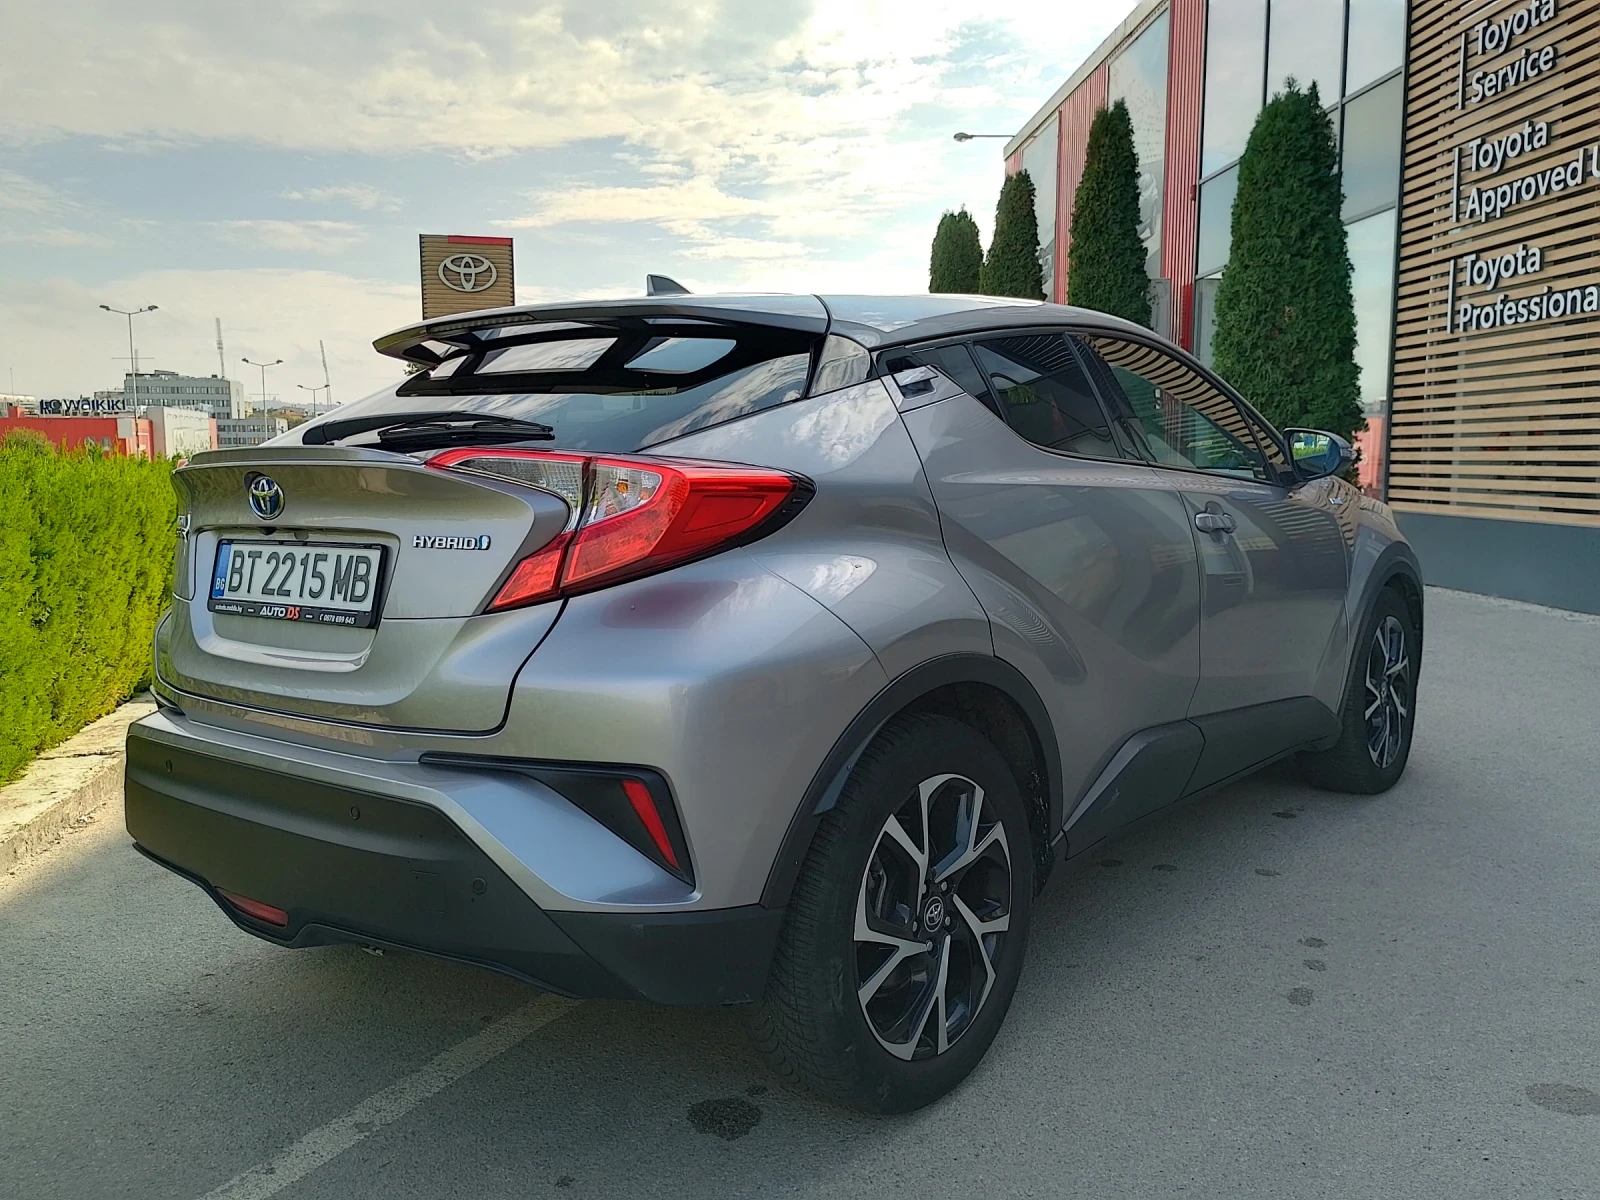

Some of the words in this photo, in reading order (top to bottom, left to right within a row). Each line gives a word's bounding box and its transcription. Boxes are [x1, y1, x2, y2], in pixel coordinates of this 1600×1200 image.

[1474, 0, 1556, 55] Toyota
[1471, 46, 1555, 104] Service
[1469, 120, 1548, 173] Toyota
[1465, 148, 1584, 222] Approved
[1463, 244, 1541, 291] Toyota
[412, 535, 476, 550] HYBRID
[215, 578, 225, 590] BG
[227, 550, 263, 594] BT
[261, 551, 328, 599] 2215
[329, 554, 372, 603] MB
[259, 606, 286, 618] AUTO
